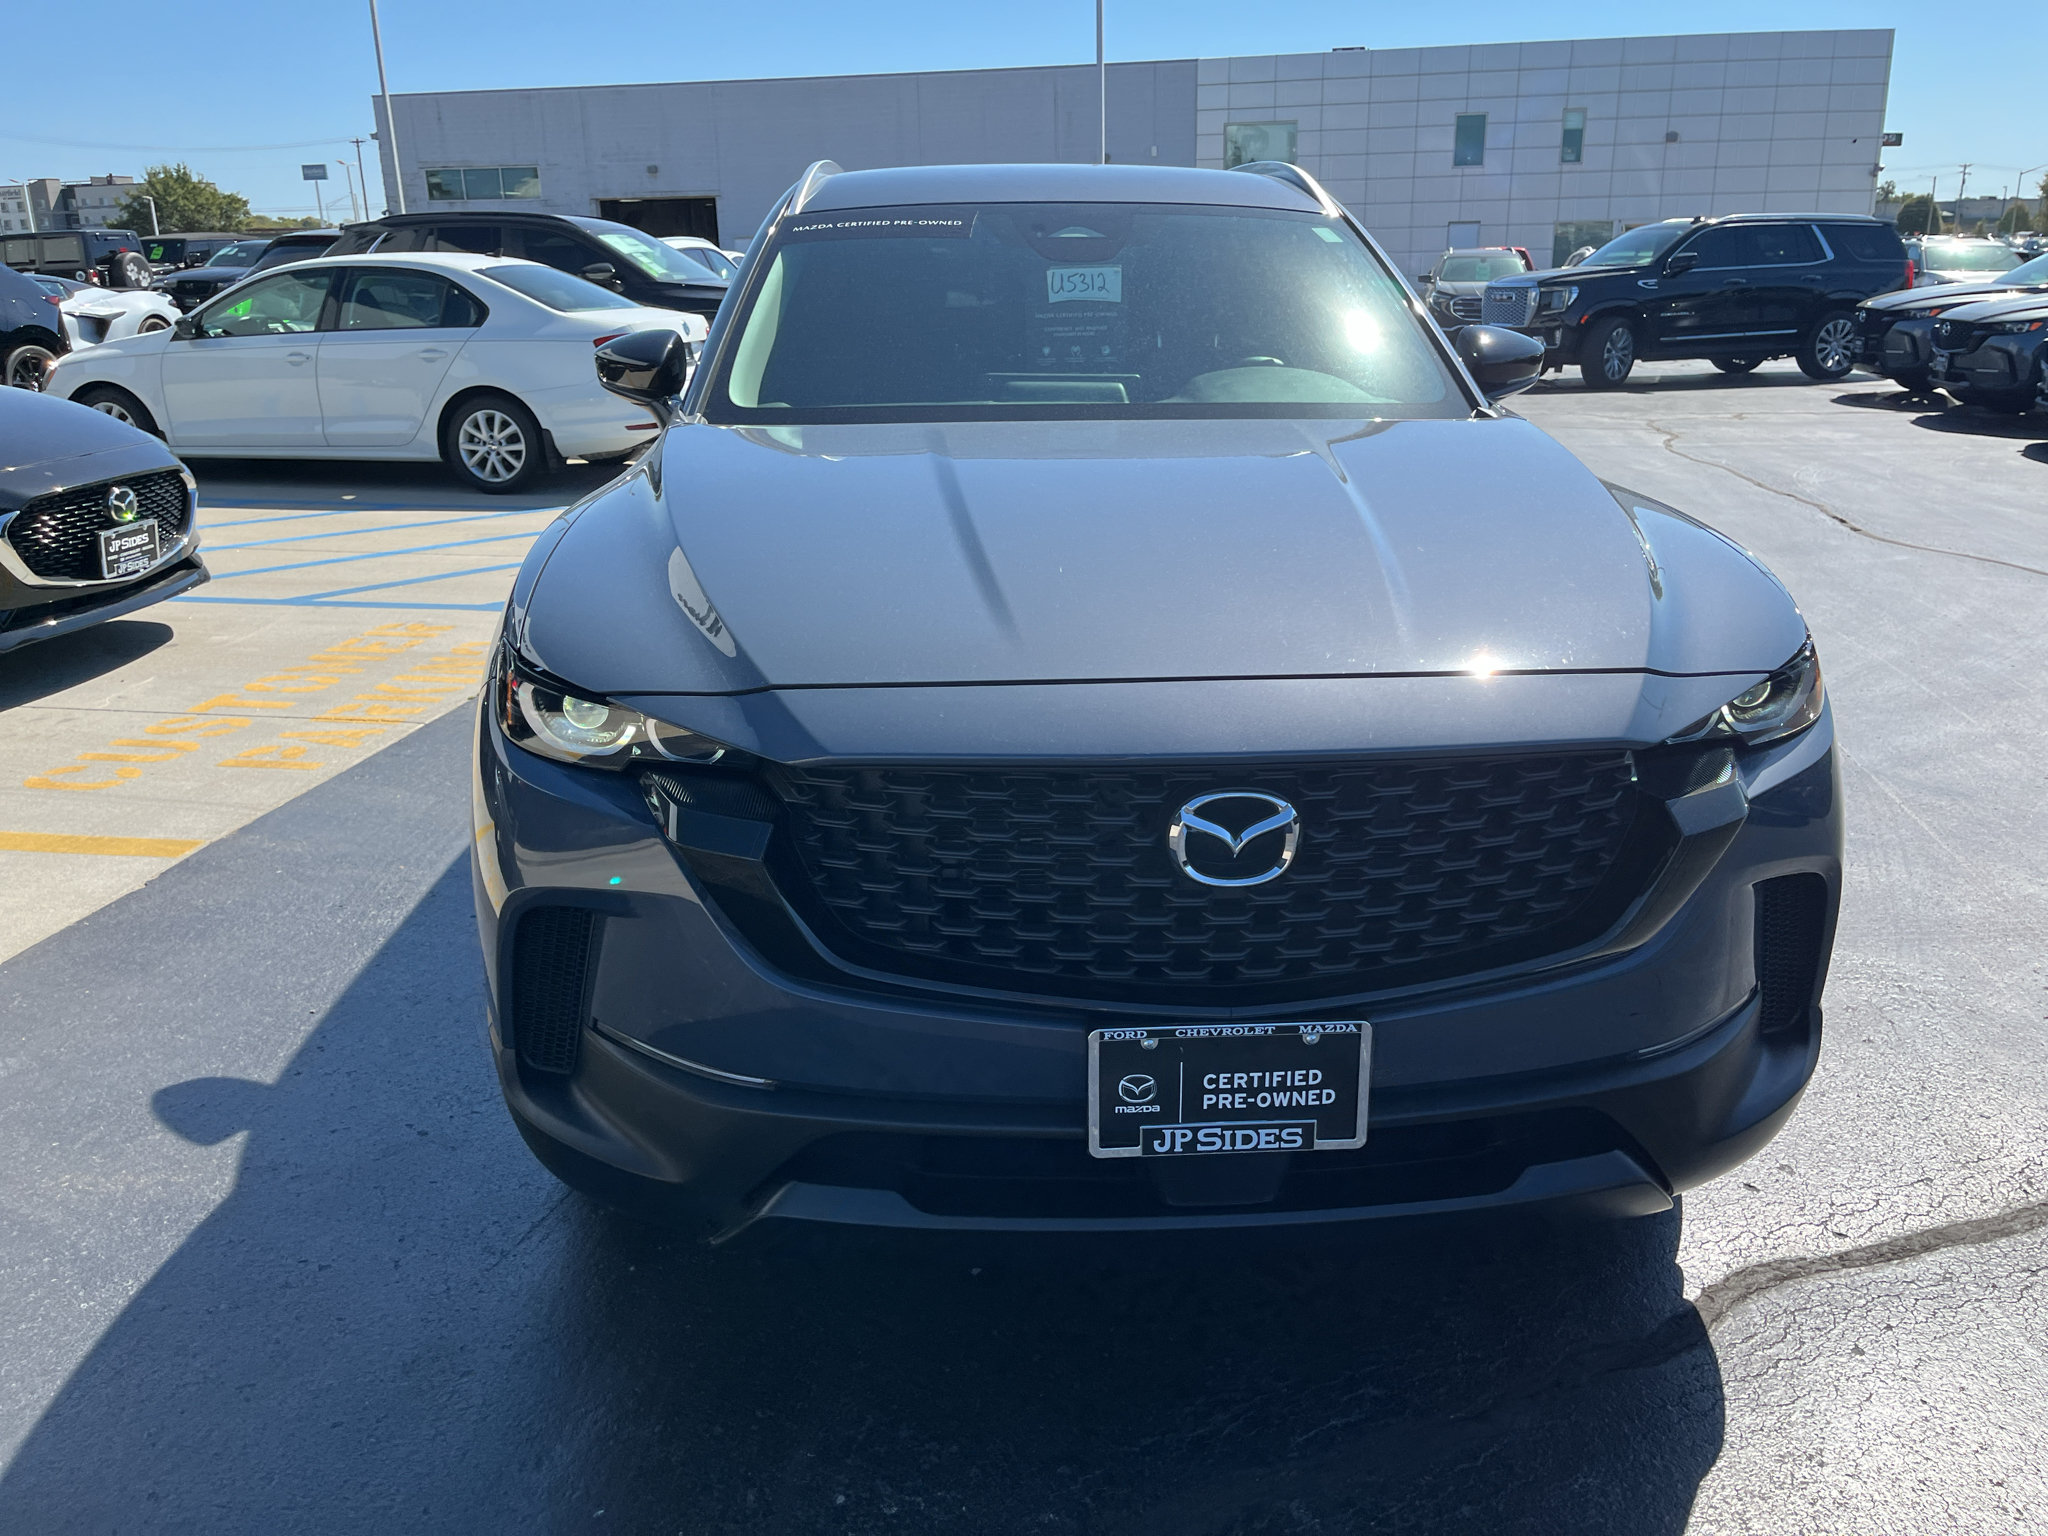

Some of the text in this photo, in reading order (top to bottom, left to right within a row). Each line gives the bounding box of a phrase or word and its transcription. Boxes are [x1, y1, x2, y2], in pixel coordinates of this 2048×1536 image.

[792, 219, 962, 232] MAZDA CERTIFIED PRE-OWNED
[1051, 271, 1110, 294] U5312
[109, 533, 149, 552] JP SIDES
[23, 623, 456, 791] CUSTOMER
[1103, 1023, 1358, 1041] FORD CHEVROLET MAZDA
[1203, 1069, 1322, 1090] CERTIFIED
[1203, 1088, 1336, 1110] PRE-OWNED
[1153, 1127, 1303, 1153] JP SIDES
